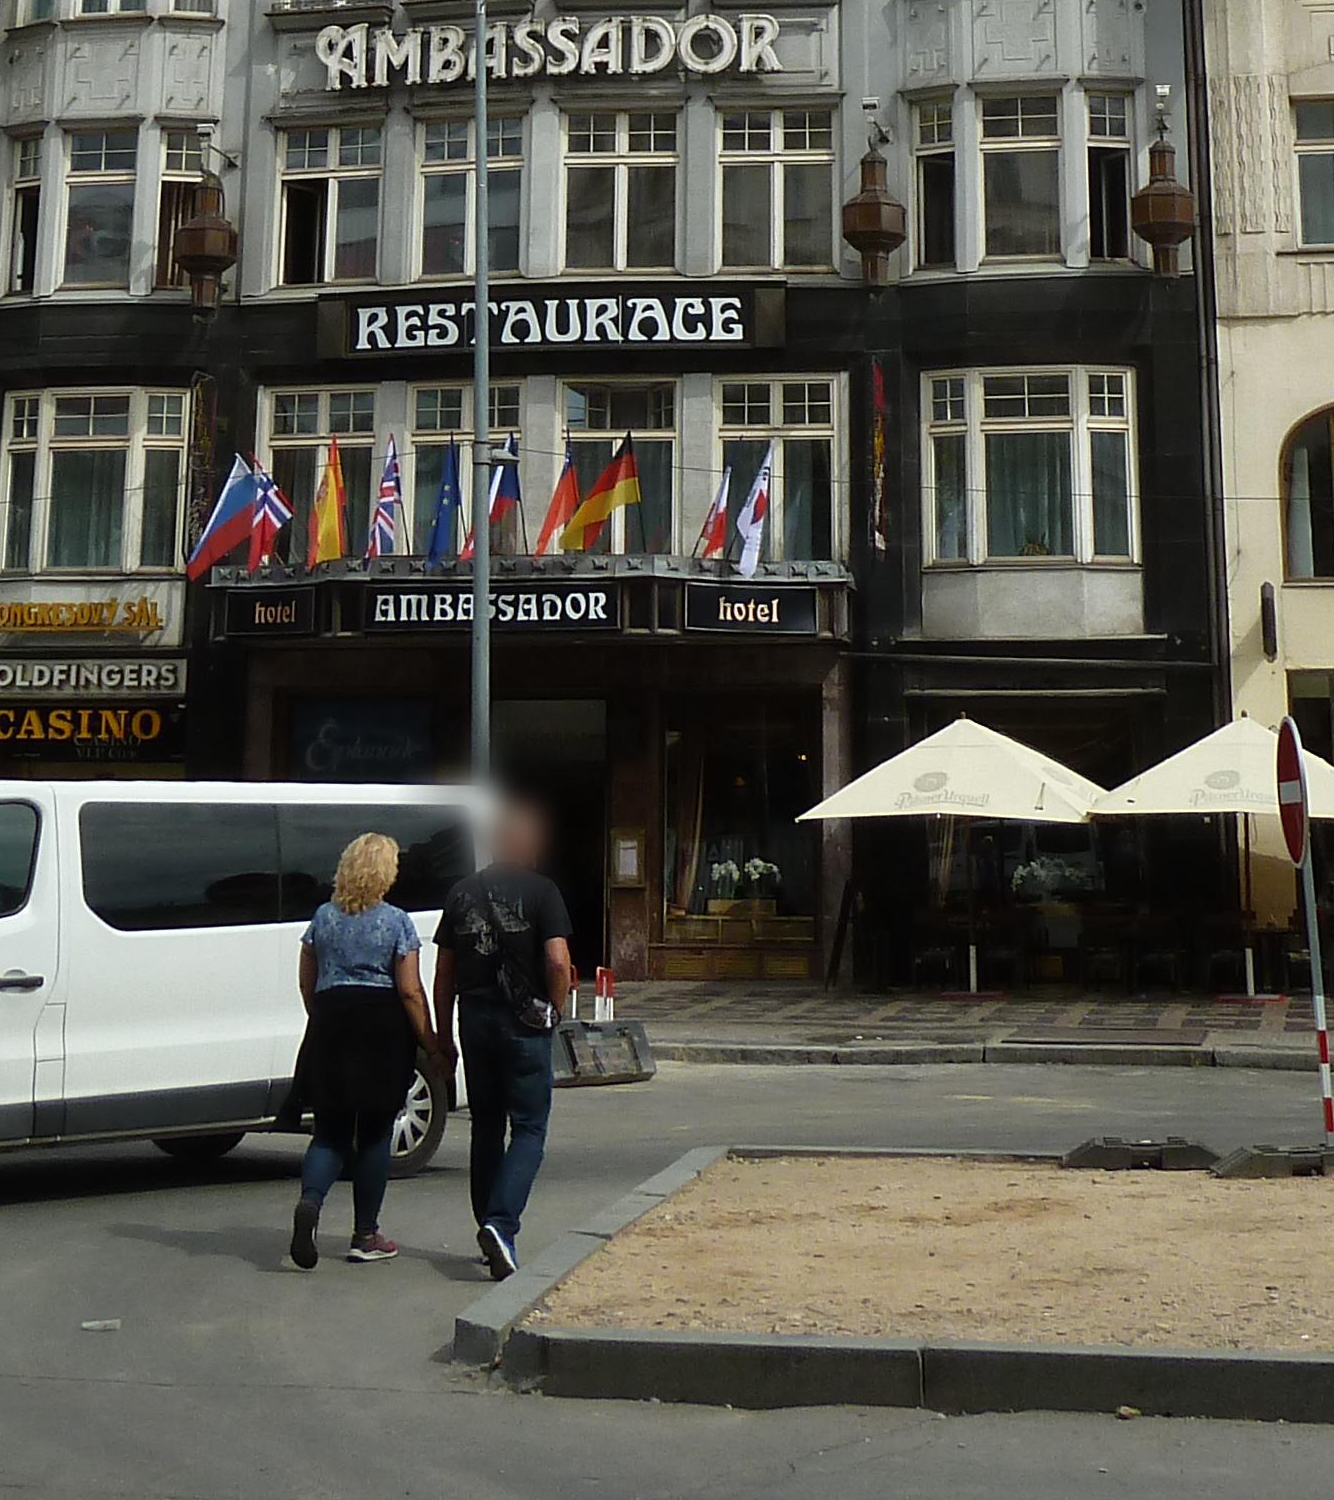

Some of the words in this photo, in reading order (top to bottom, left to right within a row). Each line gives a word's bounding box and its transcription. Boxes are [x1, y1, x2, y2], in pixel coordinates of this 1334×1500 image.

[315, 14, 784, 91] AMBASSADOR
[356, 297, 744, 350] RESTAURACE
[122, 596, 164, 628] SÁL
[254, 600, 297, 624] hotel
[718, 598, 780, 624] hotel
